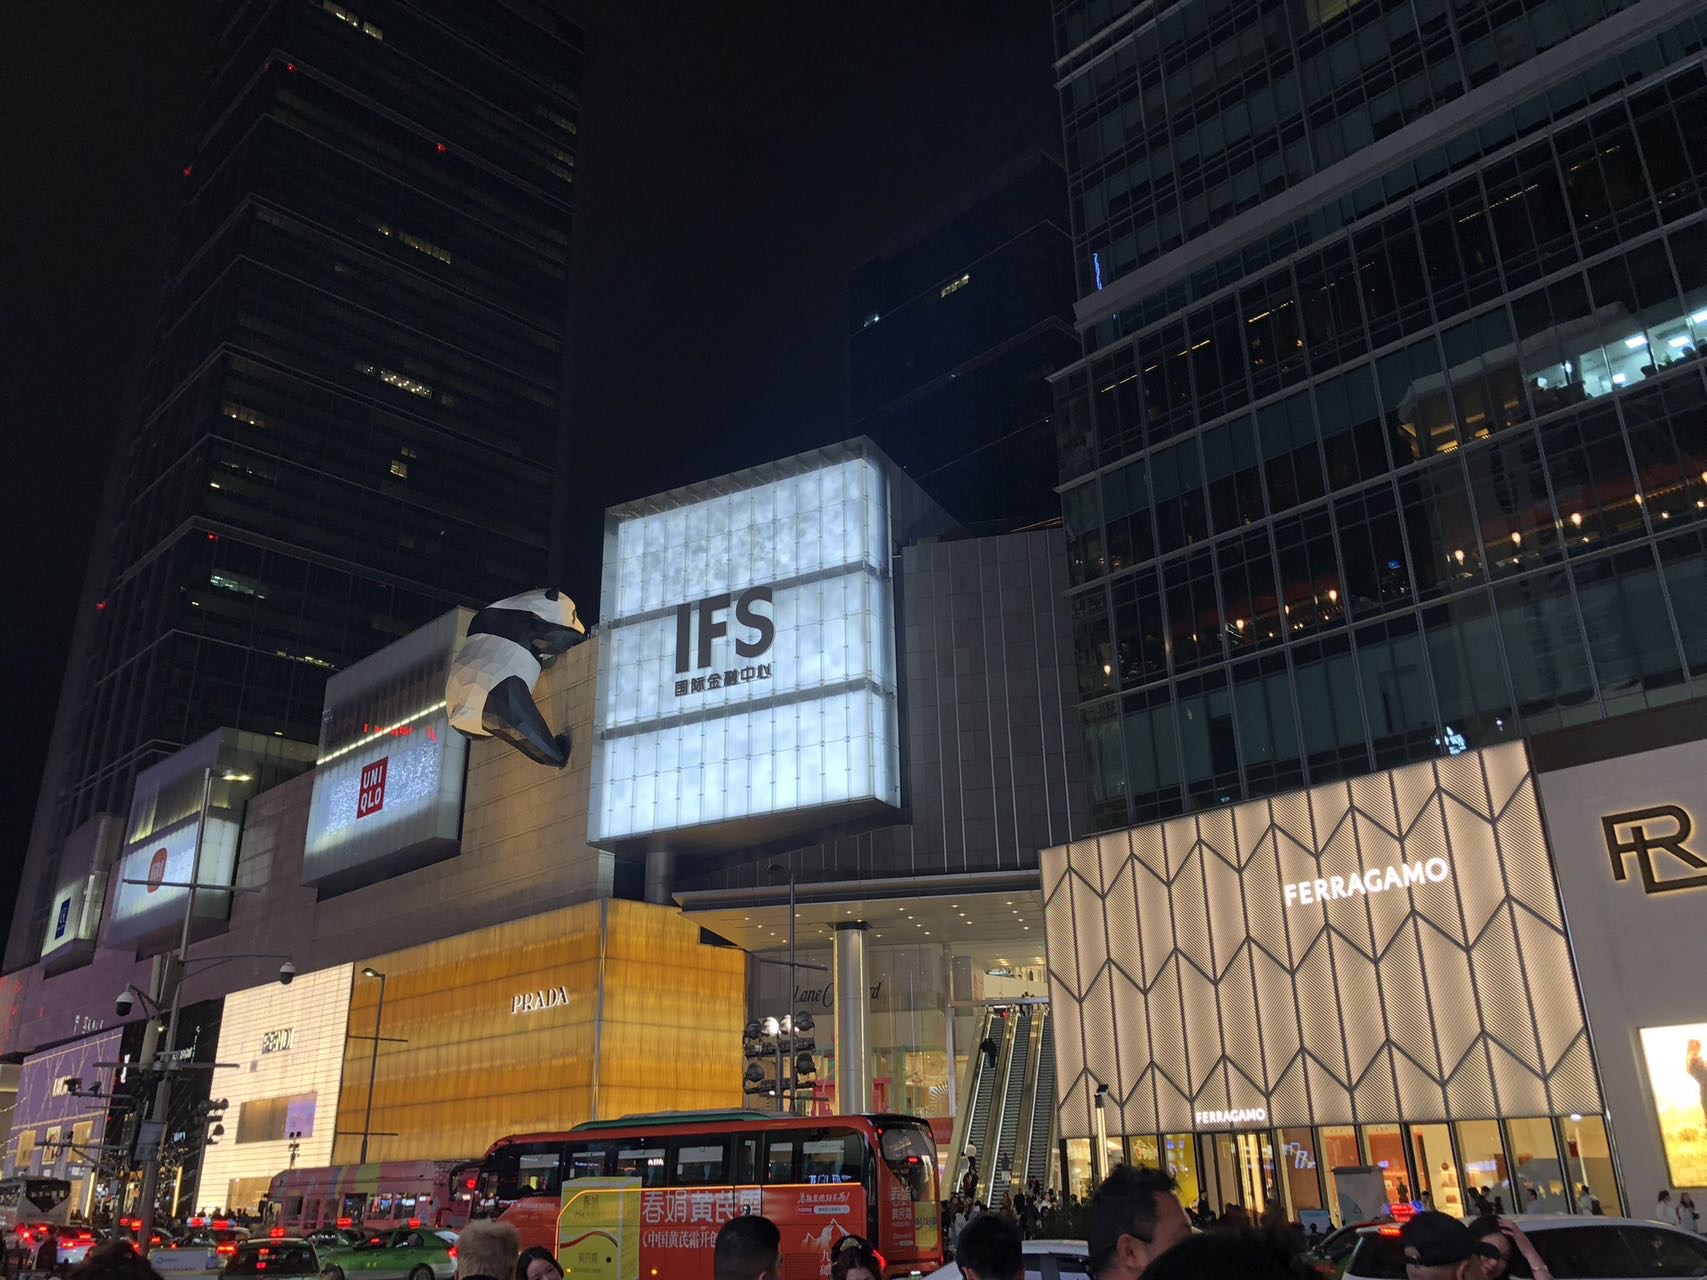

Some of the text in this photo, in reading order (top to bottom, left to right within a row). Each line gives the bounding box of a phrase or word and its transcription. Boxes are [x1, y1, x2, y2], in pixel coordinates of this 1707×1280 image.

[675, 586, 775, 674] IFS
[674, 662, 773, 697] 国际金融中心
[362, 764, 384, 789] UNI
[360, 786, 382, 813] QLO
[1284, 857, 1449, 908] FERRAGAMO
[511, 986, 569, 1015] PRADA
[262, 1027, 296, 1054] FENDI
[1195, 1107, 1266, 1123] FERRAGAMO
